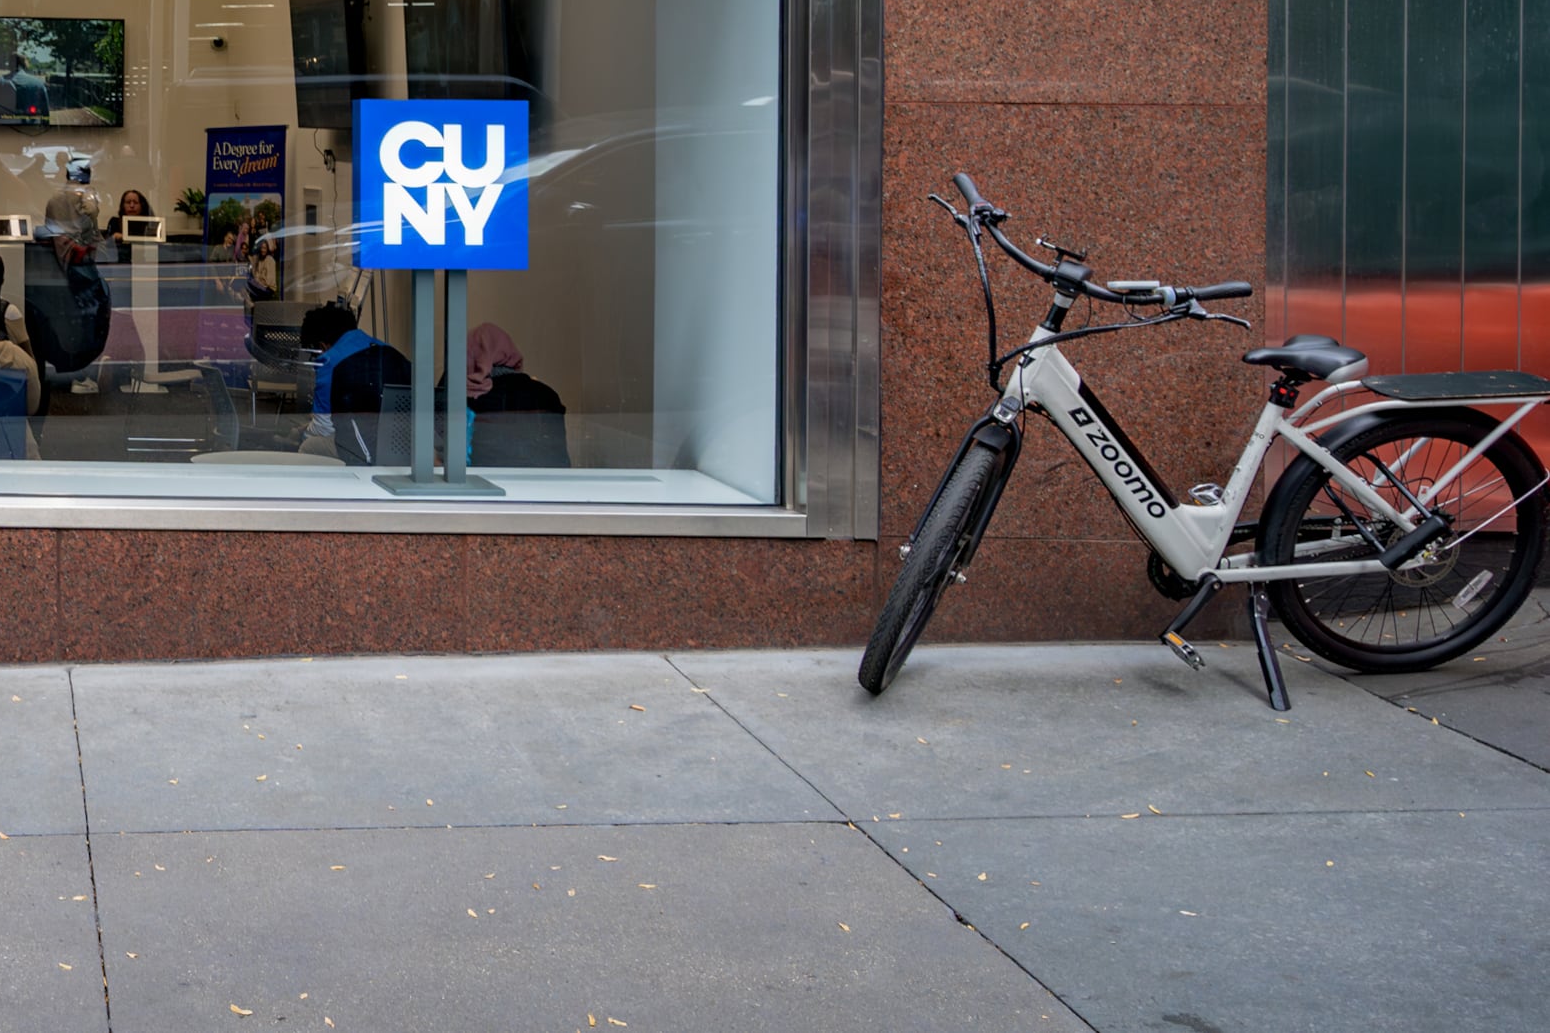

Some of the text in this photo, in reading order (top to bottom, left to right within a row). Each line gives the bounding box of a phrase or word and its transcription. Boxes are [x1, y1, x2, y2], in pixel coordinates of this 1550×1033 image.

[213, 140, 275, 157] A Degree for
[213, 154, 278, 175] Every dream
[379, 120, 505, 188] CU
[383, 182, 505, 246] NY
[1086, 429, 1166, 518] zoomo
